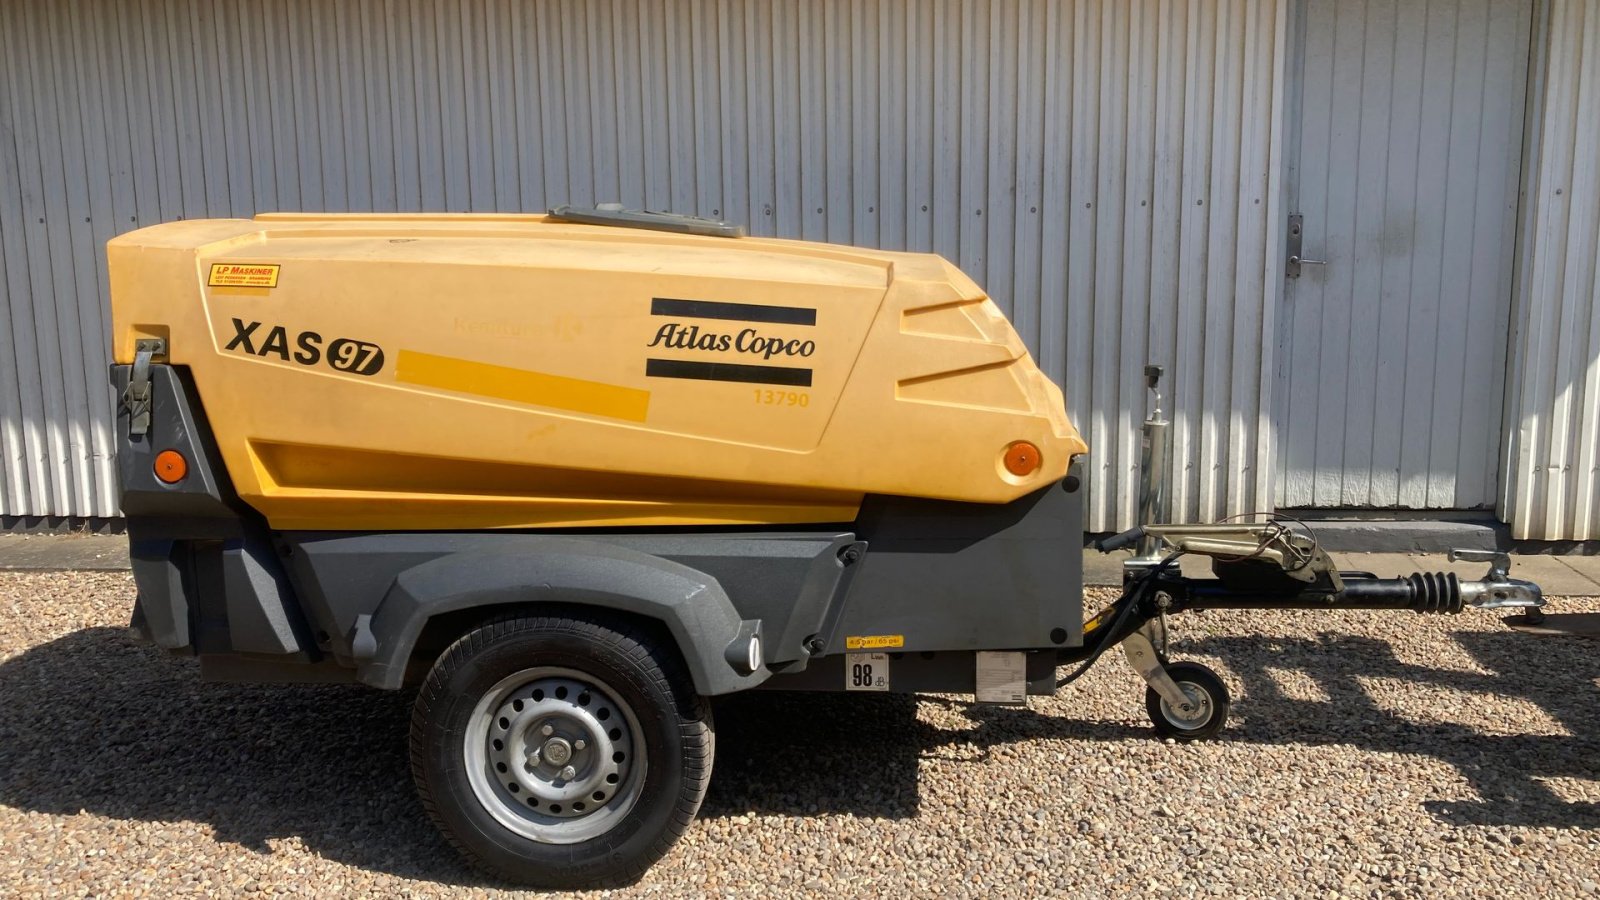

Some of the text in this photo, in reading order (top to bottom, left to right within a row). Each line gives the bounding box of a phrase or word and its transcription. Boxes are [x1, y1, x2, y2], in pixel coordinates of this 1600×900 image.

[216, 266, 229, 274] LP
[224, 317, 379, 373] XAS 97
[647, 323, 816, 360] Atlas Copco
[753, 388, 810, 408] 13790
[853, 664, 872, 687] 98
